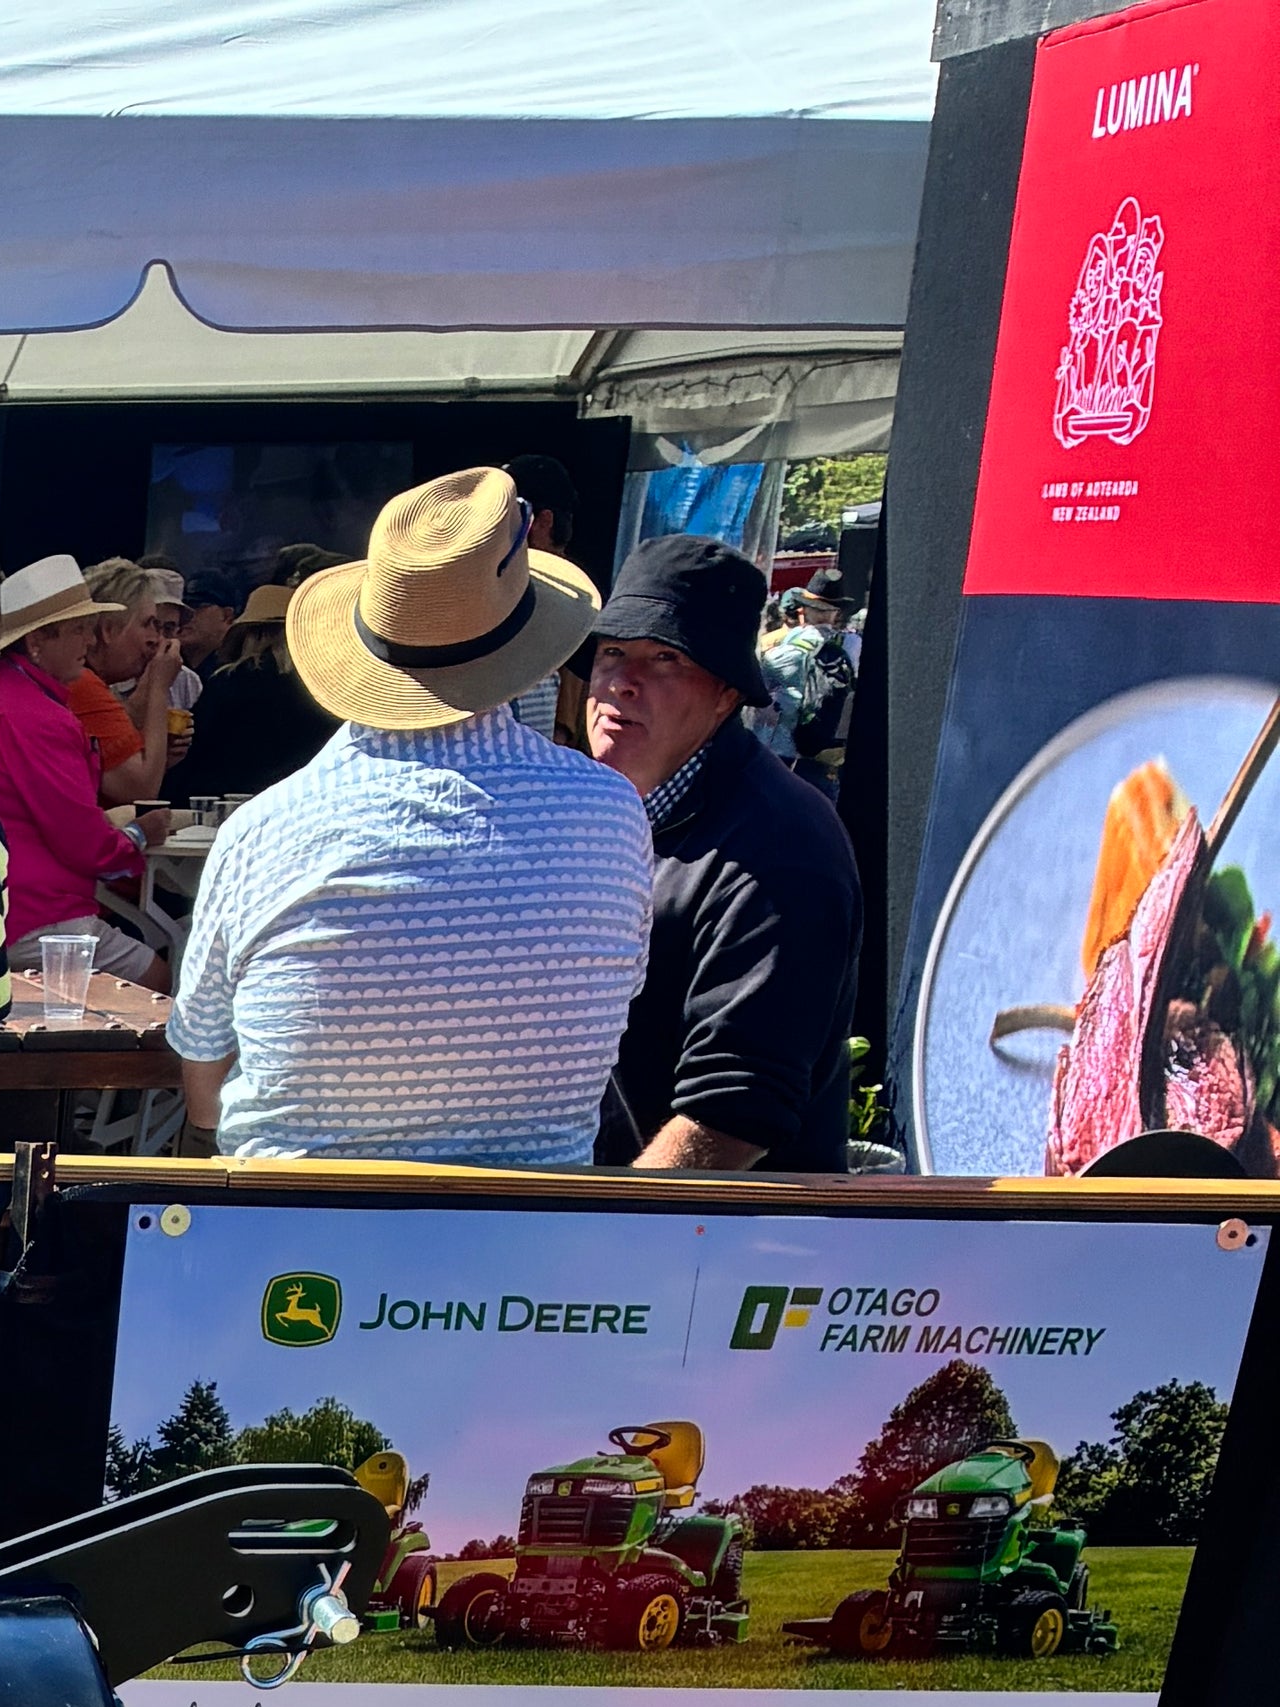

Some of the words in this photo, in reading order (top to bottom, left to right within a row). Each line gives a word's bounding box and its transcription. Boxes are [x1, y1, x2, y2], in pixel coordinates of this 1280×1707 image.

[1091, 64, 1192, 139] LUMINA
[1052, 506, 1074, 521] NEW
[1074, 505, 1121, 521] ZEALAND
[359, 1293, 487, 1332] JOHN
[498, 1295, 651, 1334] DEERE
[828, 1287, 940, 1317] OTAGO
[820, 1324, 912, 1353] FARM
[915, 1326, 1107, 1355] MACHINERY
